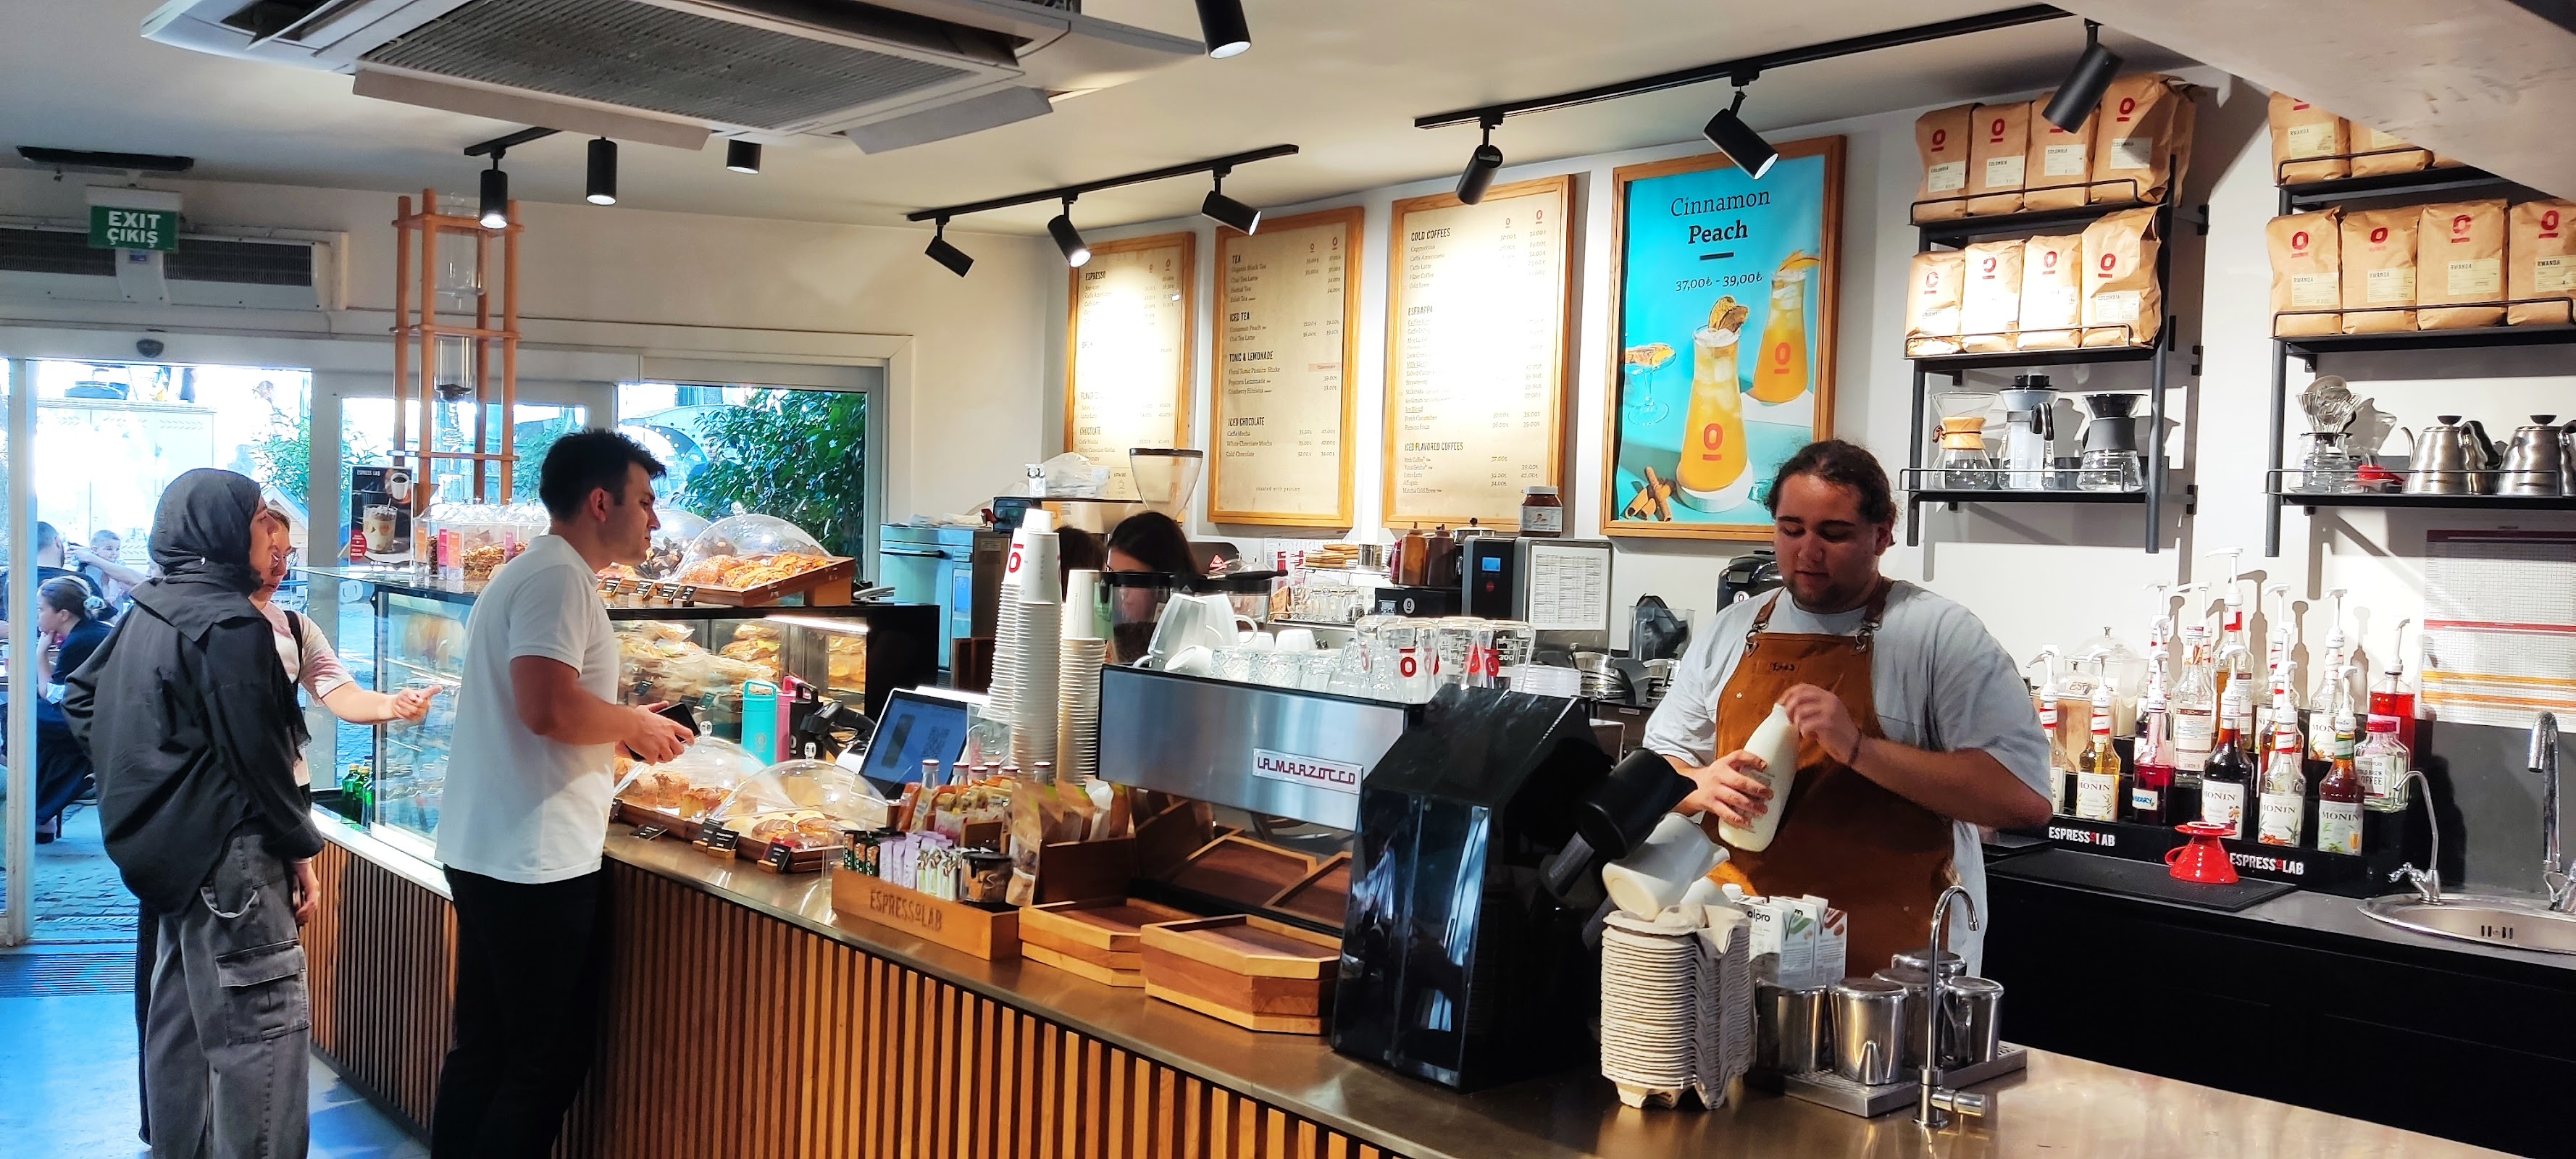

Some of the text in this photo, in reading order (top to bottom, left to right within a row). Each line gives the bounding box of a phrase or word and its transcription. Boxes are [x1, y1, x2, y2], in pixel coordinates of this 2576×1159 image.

[1671, 191, 1770, 217] Cinnamon
[109, 211, 161, 229] EXIT
[107, 227, 158, 248] ÇIKIŞ
[1411, 227, 1450, 241] COLD COFFEES
[1688, 219, 1748, 245] Peach
[1232, 255, 1241, 264] TEA
[1085, 271, 1106, 281] ESPRESSO
[1229, 311, 1250, 322] ICED TEA
[1229, 351, 1274, 362] TONIC & LEMONADE
[1228, 417, 1265, 427] ICED CHOCOLATE
[1079, 426, 1101, 435] CHOCOLATE
[1405, 442, 1463, 451] ICED FLAVORED COFFEES
[2312, 724, 2335, 732] MON
[2360, 776, 2382, 785] OFFEE
[2322, 811, 2359, 821] MONIN
[870, 891, 942, 931] ESPRESSOLAB
[1747, 908, 1770, 923] alpro
